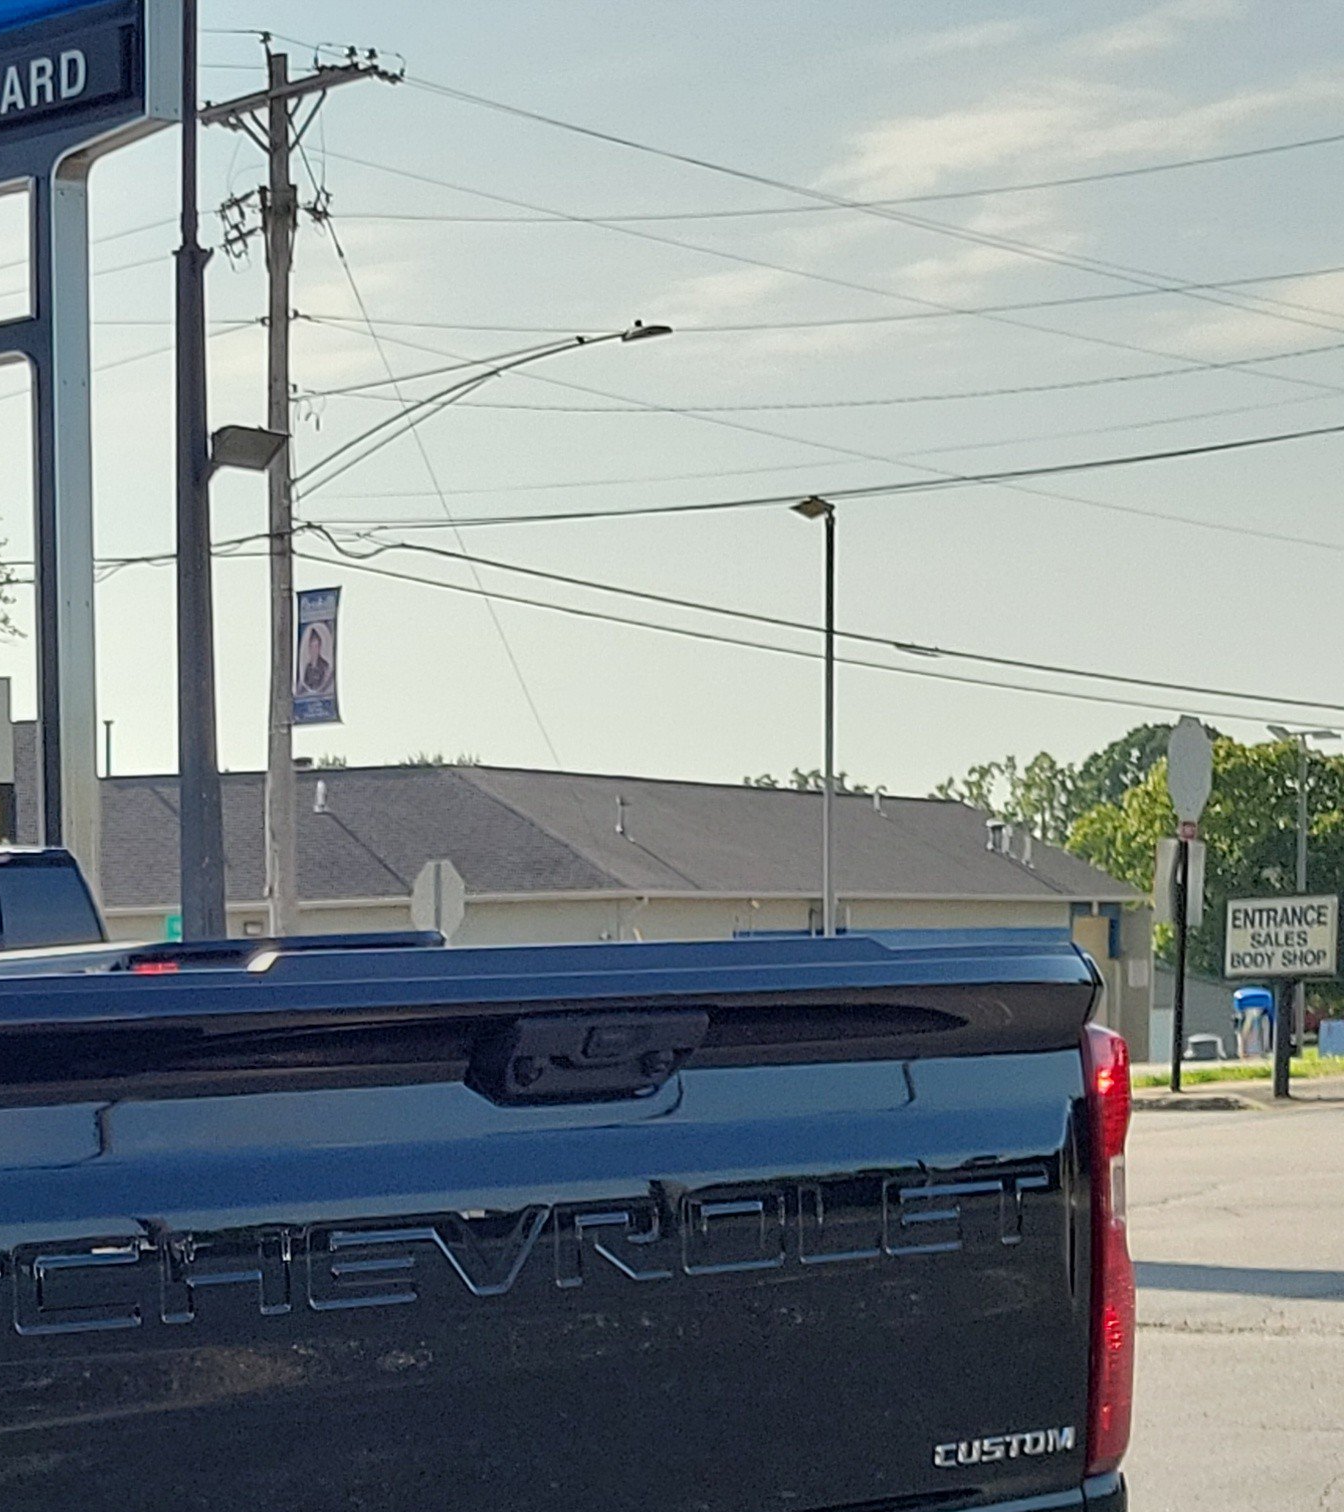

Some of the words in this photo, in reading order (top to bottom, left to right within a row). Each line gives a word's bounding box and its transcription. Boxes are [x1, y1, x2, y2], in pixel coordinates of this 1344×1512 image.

[1232, 904, 1329, 928] ENTRANCE
[1250, 930, 1309, 949] SALES
[1230, 952, 1275, 969] BODY
[1281, 949, 1327, 968] SHOP
[13, 1168, 1049, 1336] CHEVROLET
[934, 1426, 1076, 1468] CUSTOM
